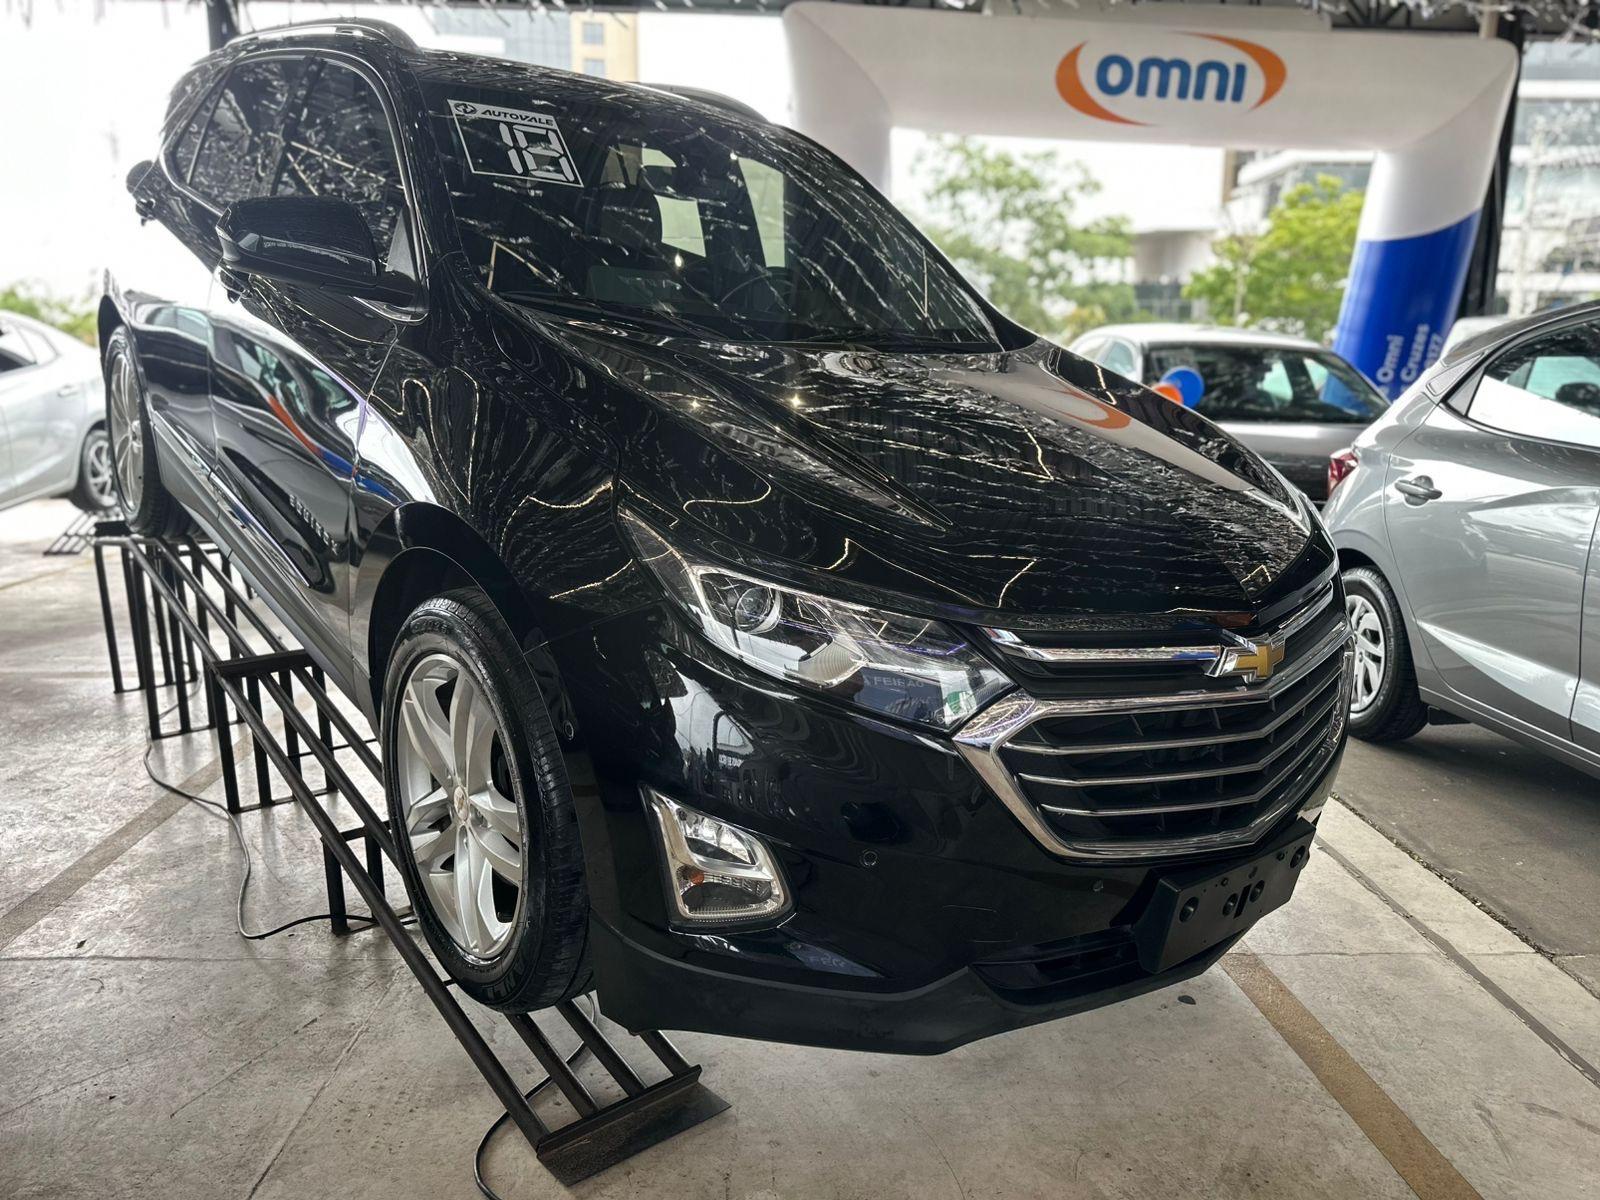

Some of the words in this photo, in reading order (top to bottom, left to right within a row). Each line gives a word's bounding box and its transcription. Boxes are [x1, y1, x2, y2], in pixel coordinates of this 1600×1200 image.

[1096, 54, 1247, 103] omni
[481, 108, 555, 127] AUTOVALE
[498, 121, 575, 183] 18
